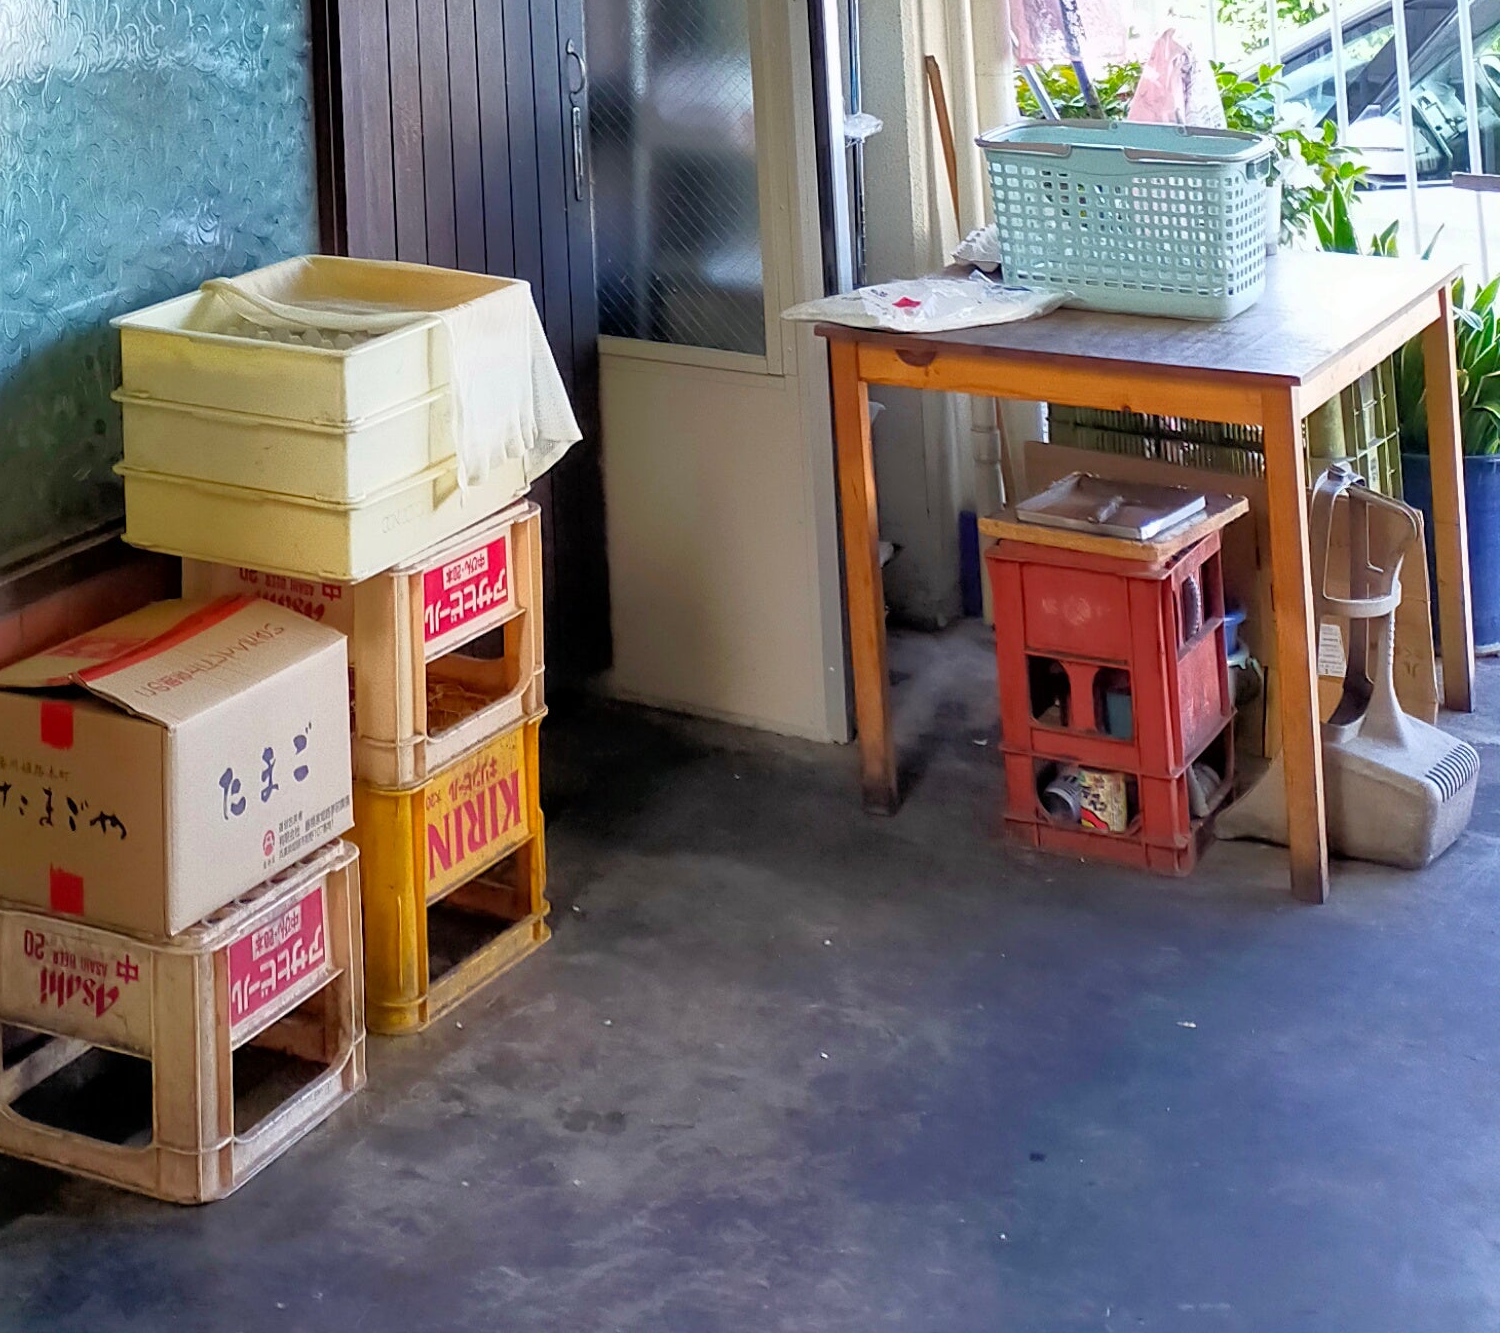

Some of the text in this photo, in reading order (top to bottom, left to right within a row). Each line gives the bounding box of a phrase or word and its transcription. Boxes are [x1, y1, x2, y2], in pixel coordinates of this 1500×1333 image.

[425, 568, 507, 635] アサヒビール
[219, 722, 315, 819] たまご
[427, 768, 521, 882] KIRIN
[23, 929, 46, 961] 20
[116, 953, 140, 985] 中
[232, 924, 324, 1015] アサヒビール
[40, 967, 120, 1020] Asahi
